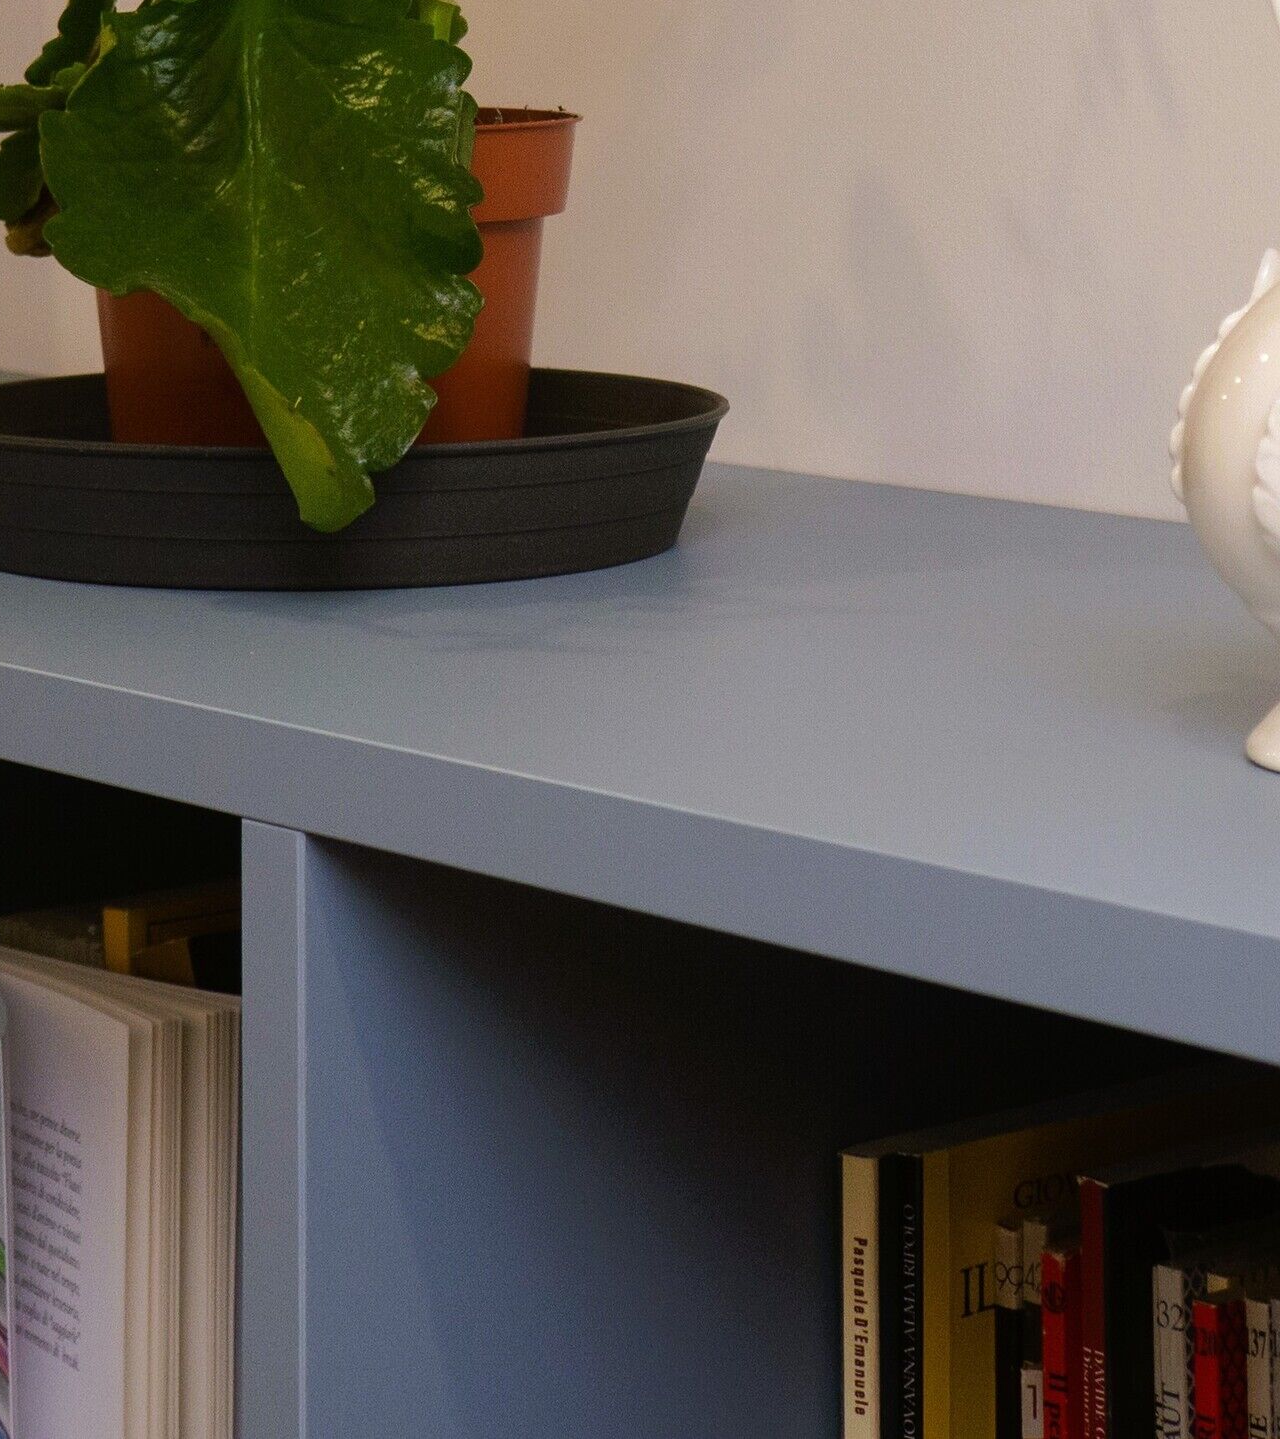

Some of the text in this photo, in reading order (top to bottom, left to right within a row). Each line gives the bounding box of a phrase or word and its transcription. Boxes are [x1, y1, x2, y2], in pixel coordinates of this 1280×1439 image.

[902, 1203, 916, 1277] RIPOLO
[851, 1236, 869, 1416] Pasquale D'Emanuele
[902, 1282, 916, 1342] ALMA
[1156, 1299, 1186, 1333] 32
[1093, 1349, 1106, 1423] DAVIDE
